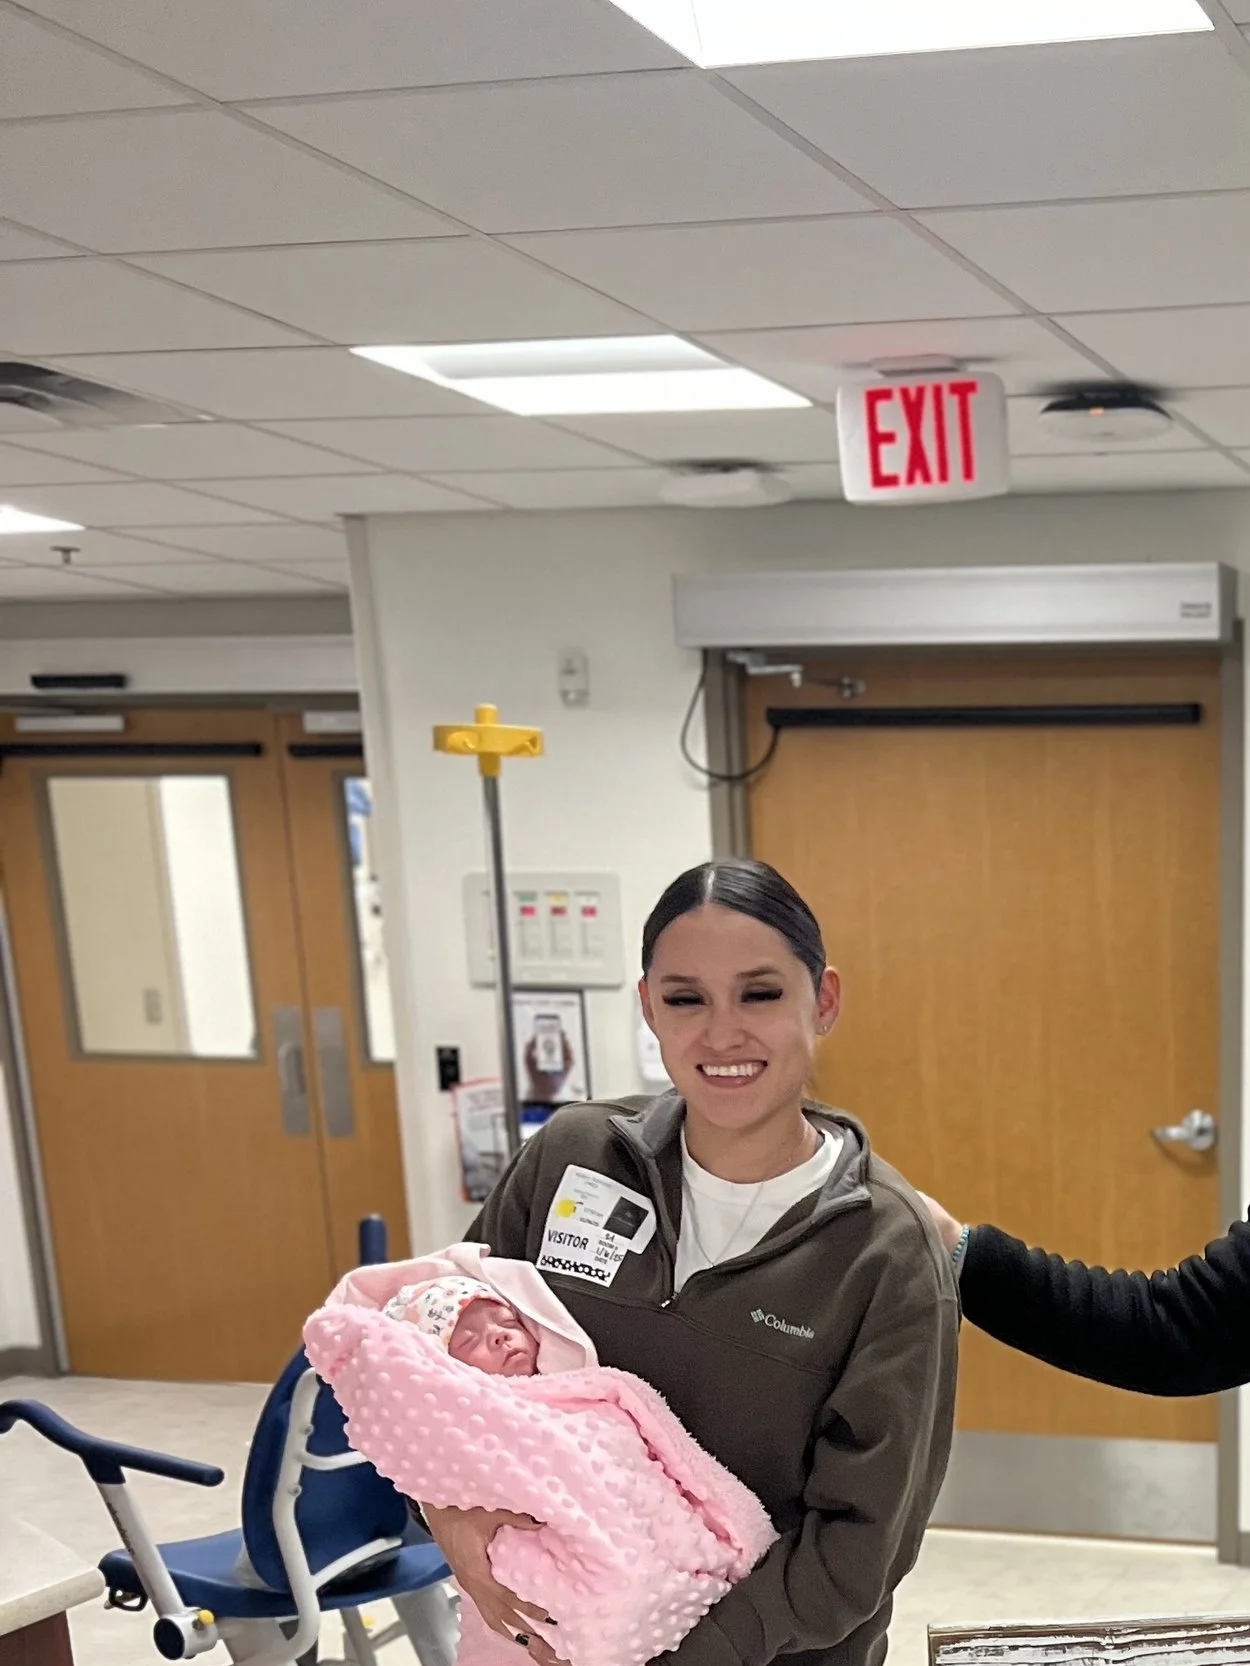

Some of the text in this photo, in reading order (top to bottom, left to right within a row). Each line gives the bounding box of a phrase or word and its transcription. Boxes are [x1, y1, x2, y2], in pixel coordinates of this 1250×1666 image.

[864, 381, 978, 488] EXIT
[547, 1229, 589, 1250] VISITOR
[764, 1314, 815, 1339] Columbia
